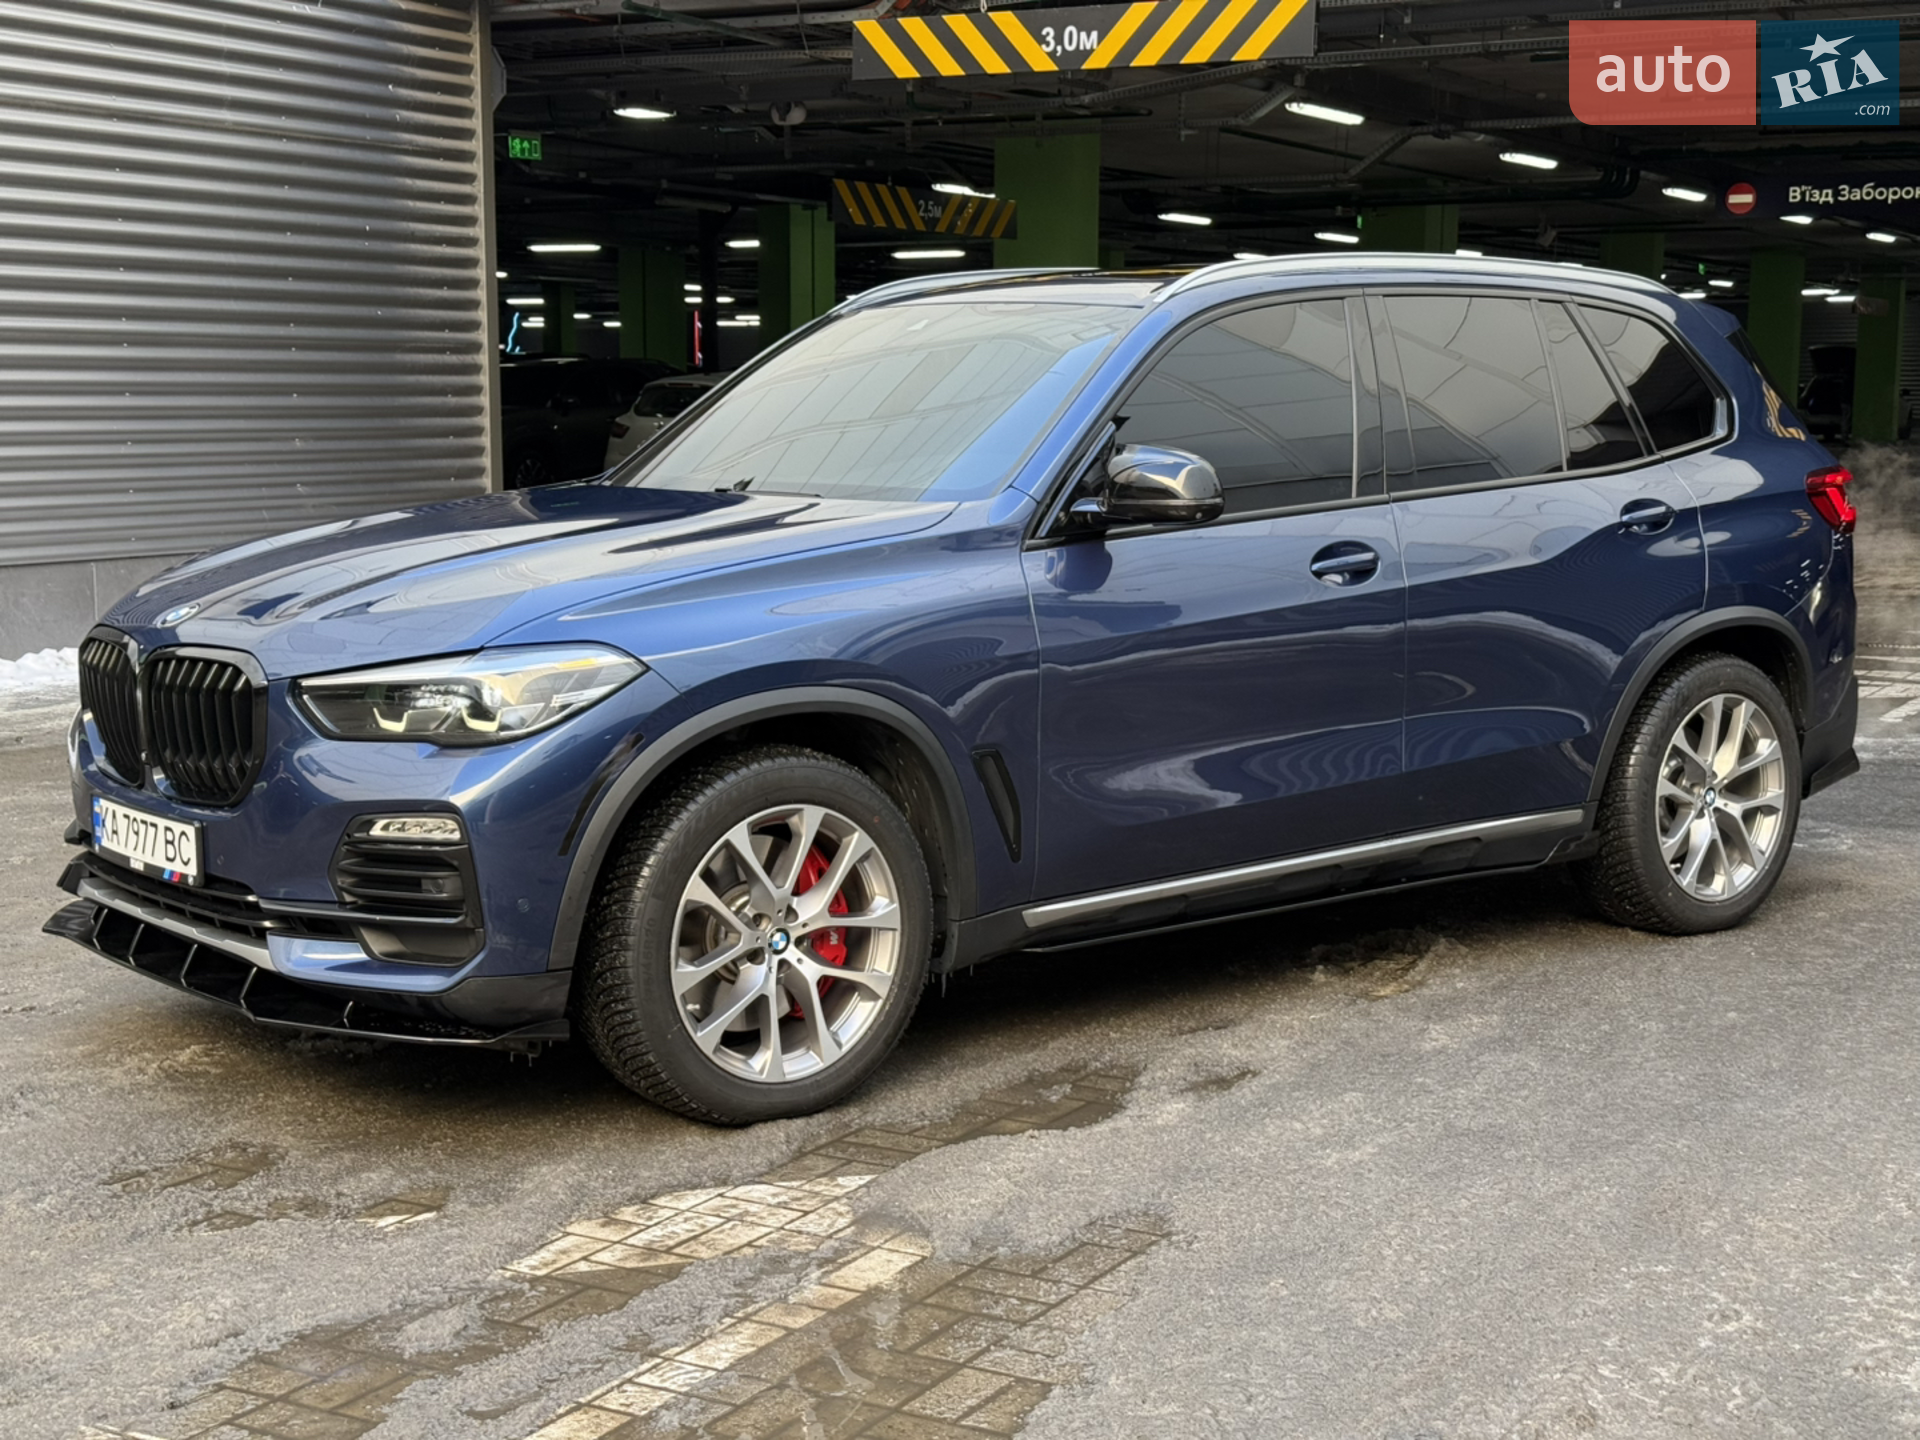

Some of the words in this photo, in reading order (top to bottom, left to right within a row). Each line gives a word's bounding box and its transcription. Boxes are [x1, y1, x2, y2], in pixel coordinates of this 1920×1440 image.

[1041, 25, 1098, 57] 3,0м
[1788, 185, 1834, 205] В'їзд
[101, 804, 120, 846] KA
[123, 812, 158, 858] 7977
[164, 825, 191, 867] BC
